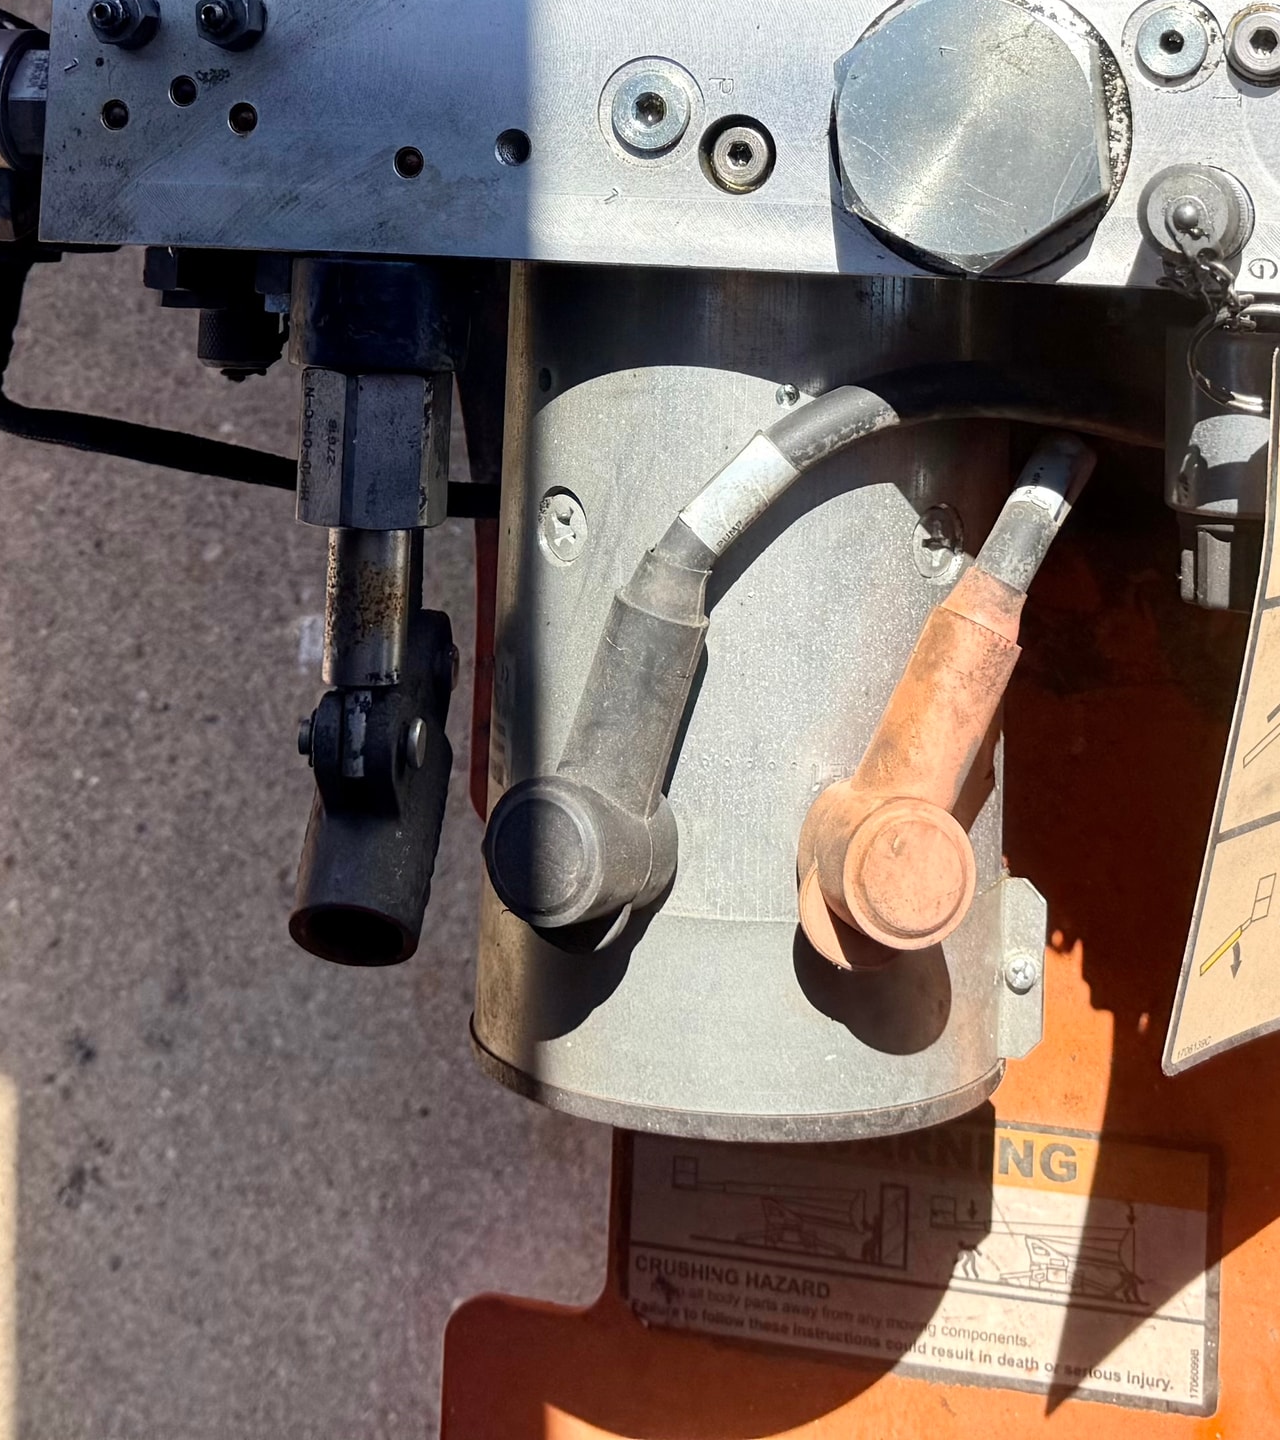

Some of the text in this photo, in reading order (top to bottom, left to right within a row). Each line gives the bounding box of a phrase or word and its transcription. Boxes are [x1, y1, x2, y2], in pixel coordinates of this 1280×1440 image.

[716, 520, 742, 549] PUMP
[635, 1253, 830, 1300] CRUSHING HAZARD
[707, 1289, 740, 1308] body
[744, 1295, 777, 1315] parts
[781, 1302, 817, 1320] away
[821, 1305, 853, 1323] from
[857, 1312, 881, 1329] any
[886, 1314, 936, 1337] moving
[940, 1323, 1032, 1349] components.
[684, 1307, 696, 1320] to
[701, 1308, 744, 1328] follow
[748, 1315, 788, 1335] these
[793, 1322, 880, 1349] instructions
[885, 1335, 926, 1355] could
[931, 1343, 973, 1362] result
[978, 1349, 992, 1364] in
[997, 1352, 1039, 1371] death
[1044, 1361, 1059, 1374] or
[1063, 1360, 1121, 1383] serious
[1126, 1369, 1174, 1392] injury.
